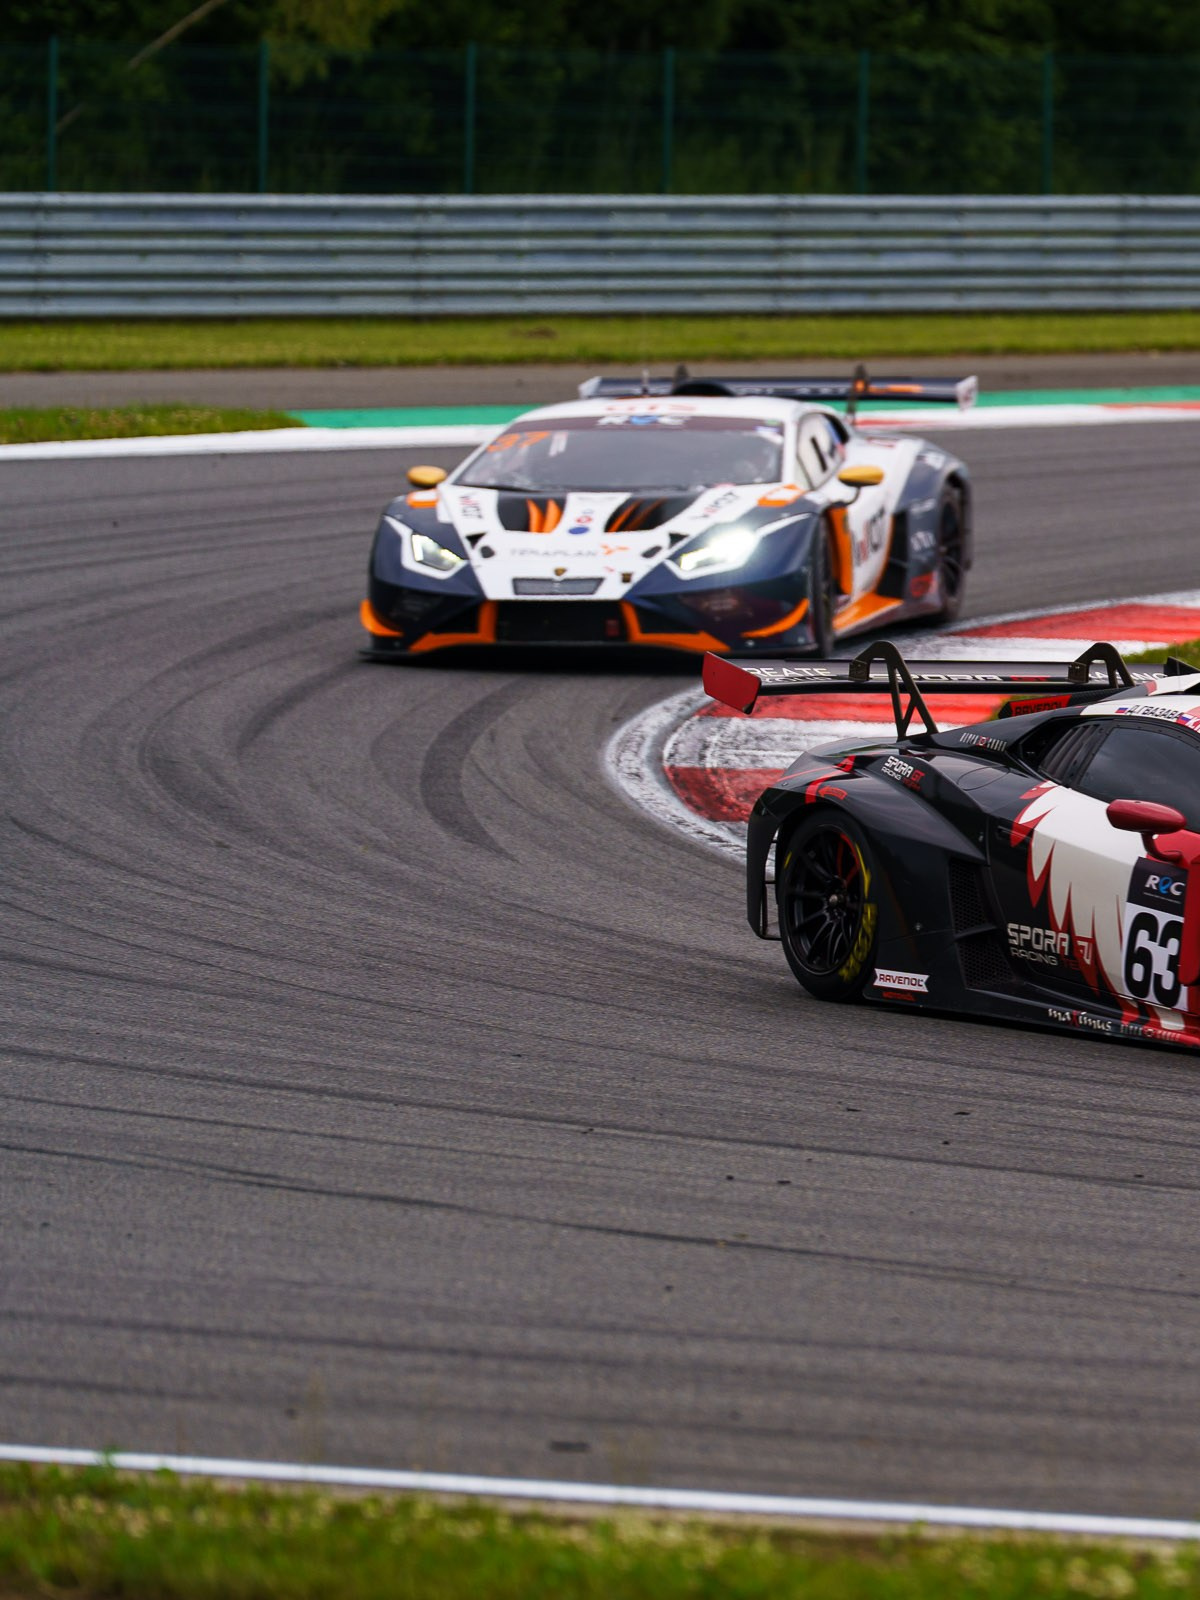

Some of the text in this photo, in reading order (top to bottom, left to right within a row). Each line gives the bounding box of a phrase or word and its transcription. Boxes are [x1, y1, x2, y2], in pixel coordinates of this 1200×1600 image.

[742, 667, 838, 677] REATE
[884, 755, 914, 779] SPORA
[1007, 922, 1070, 956] SPORA
[1010, 946, 1059, 967] RACING
[1124, 911, 1184, 1009] 63
[879, 973, 924, 988] RAVENOL
